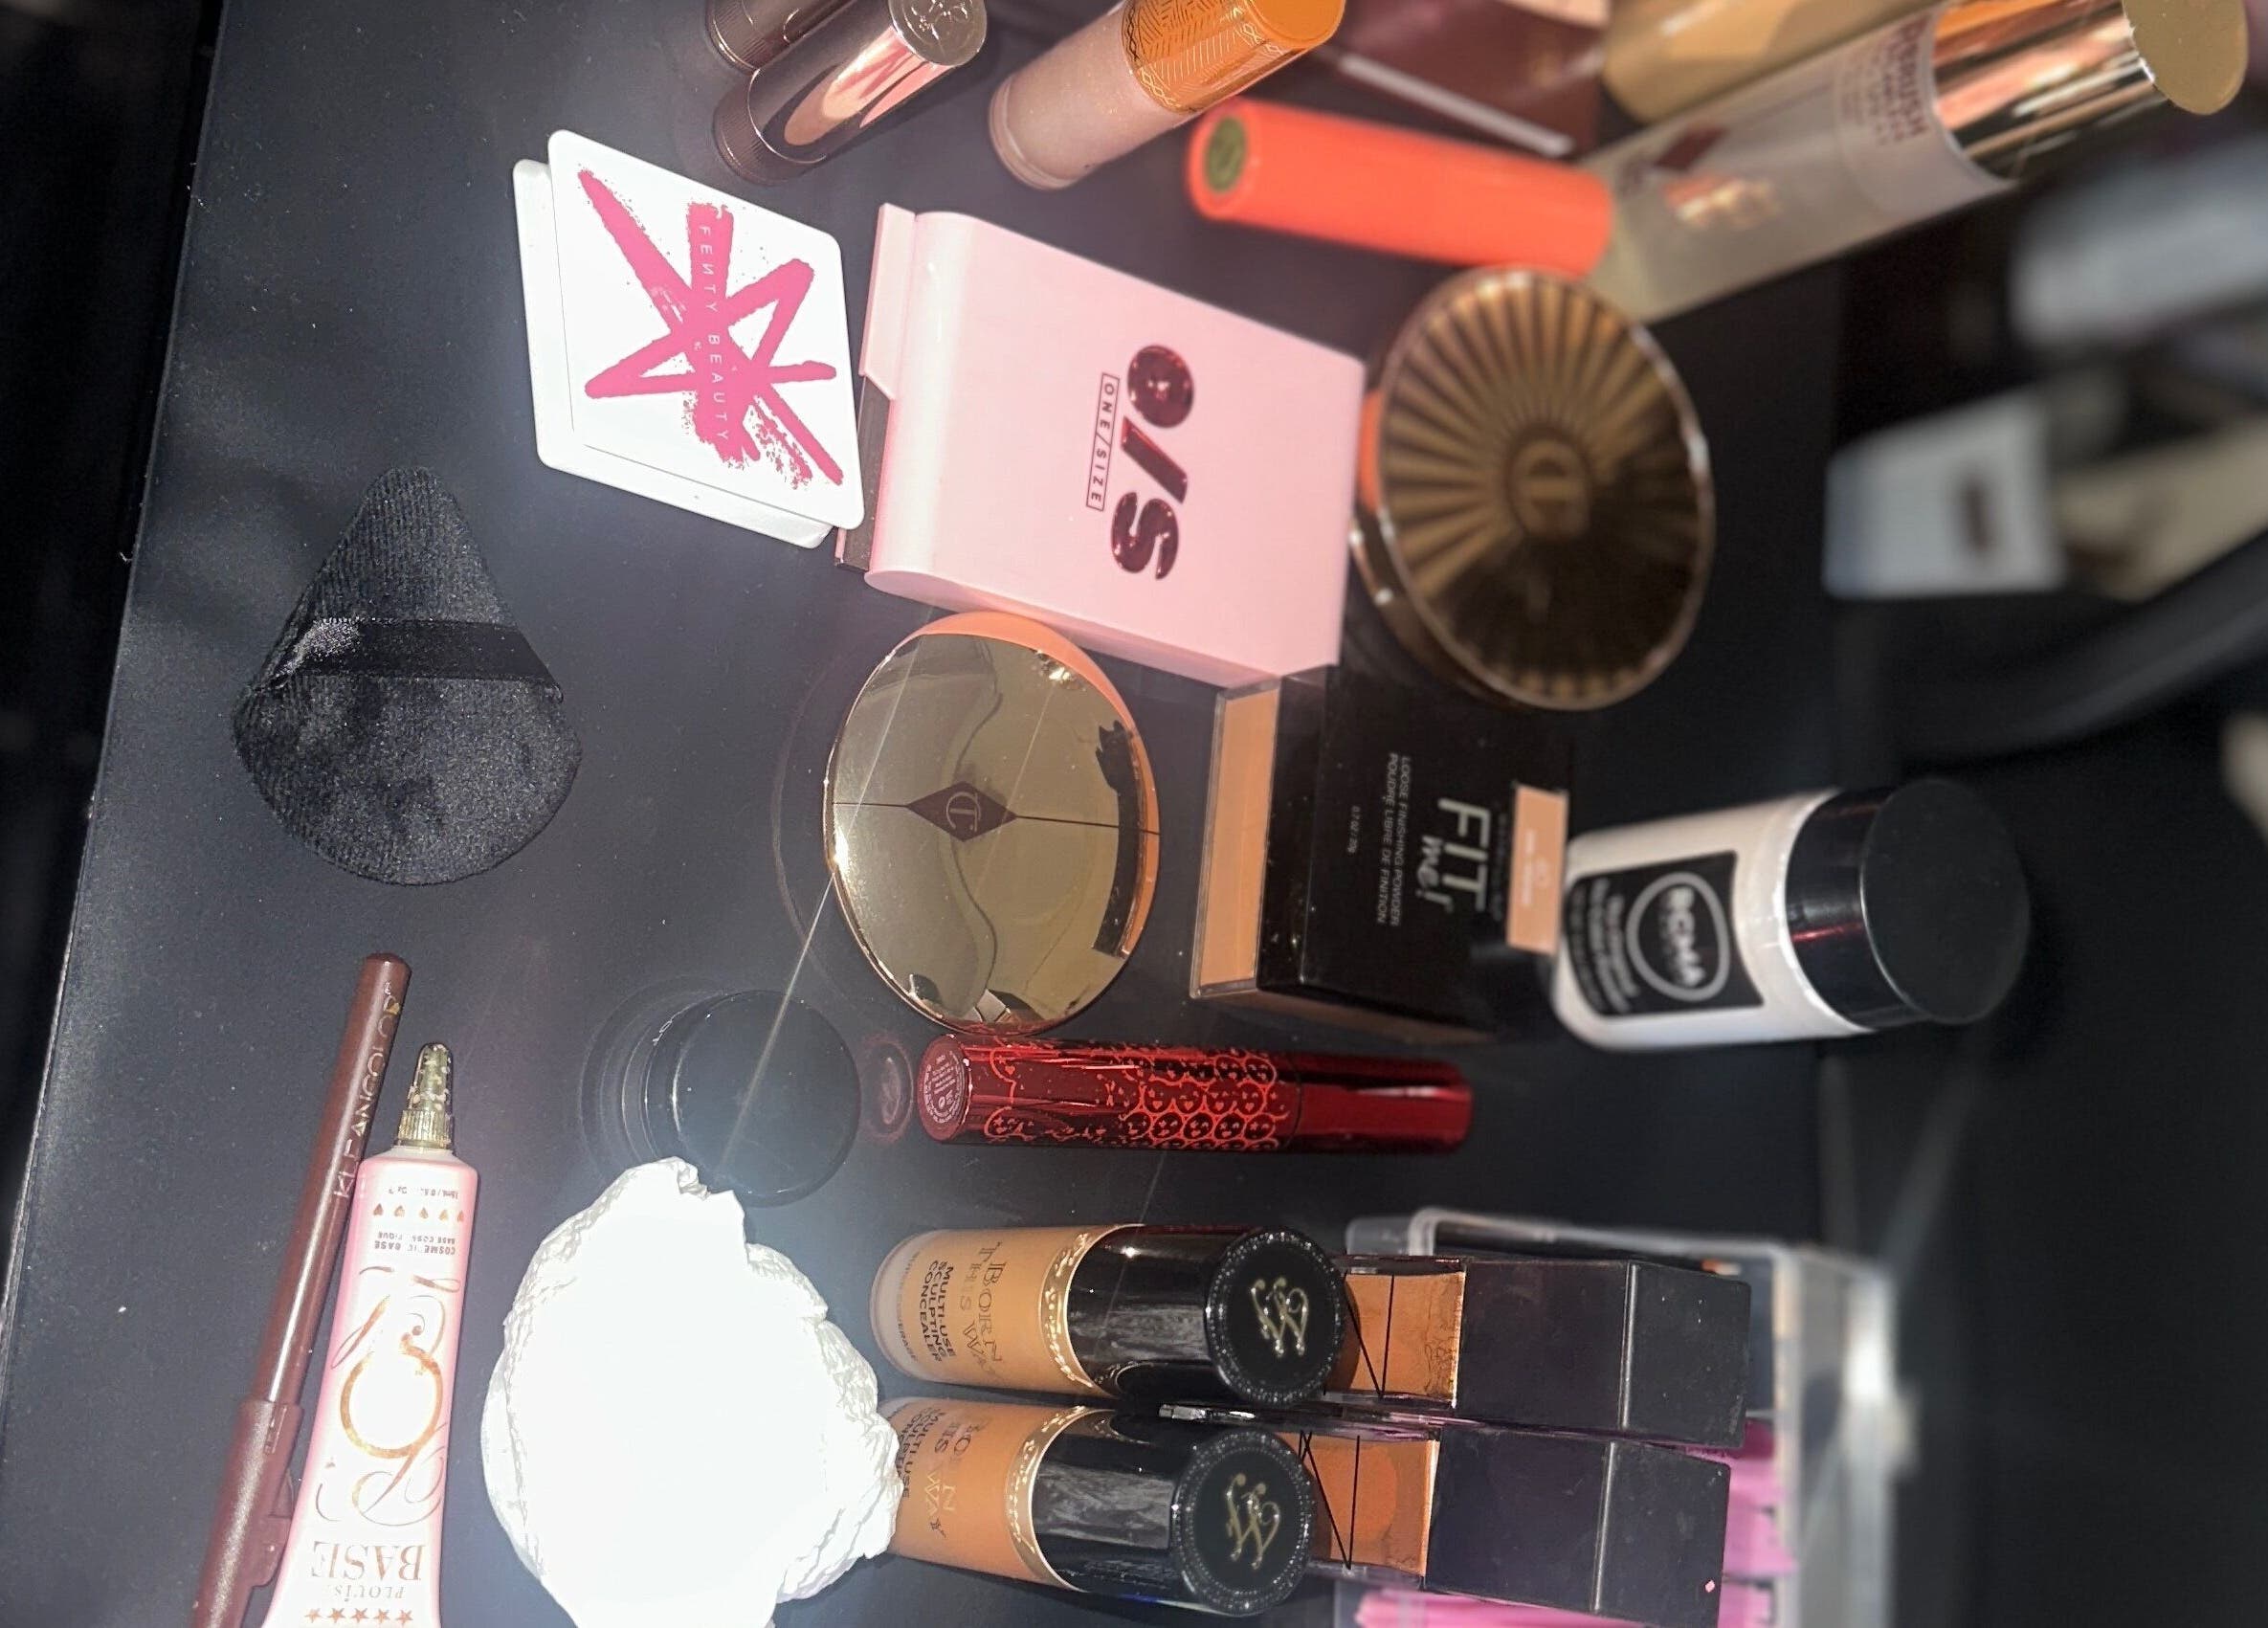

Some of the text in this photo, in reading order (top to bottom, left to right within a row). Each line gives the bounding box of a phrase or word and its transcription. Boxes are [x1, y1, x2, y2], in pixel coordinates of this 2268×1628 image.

[708, 334, 728, 440] BEAUTY
[1378, 752, 1398, 924] POUDRE LIBRE DE FINITION
[1390, 755, 1411, 926] LOOSE FINISHING POWDER
[1415, 835, 1453, 905] me!
[1437, 797, 1490, 910] FIT
[374, 1240, 456, 1255] COSMEIC BASE
[920, 1260, 943, 1363] CONCEALER
[928, 1260, 948, 1358] SCULPTING
[937, 1264, 956, 1357] MULTI-USE
[979, 1261, 1008, 1362] BORN
[311, 1540, 426, 1581] BASE
